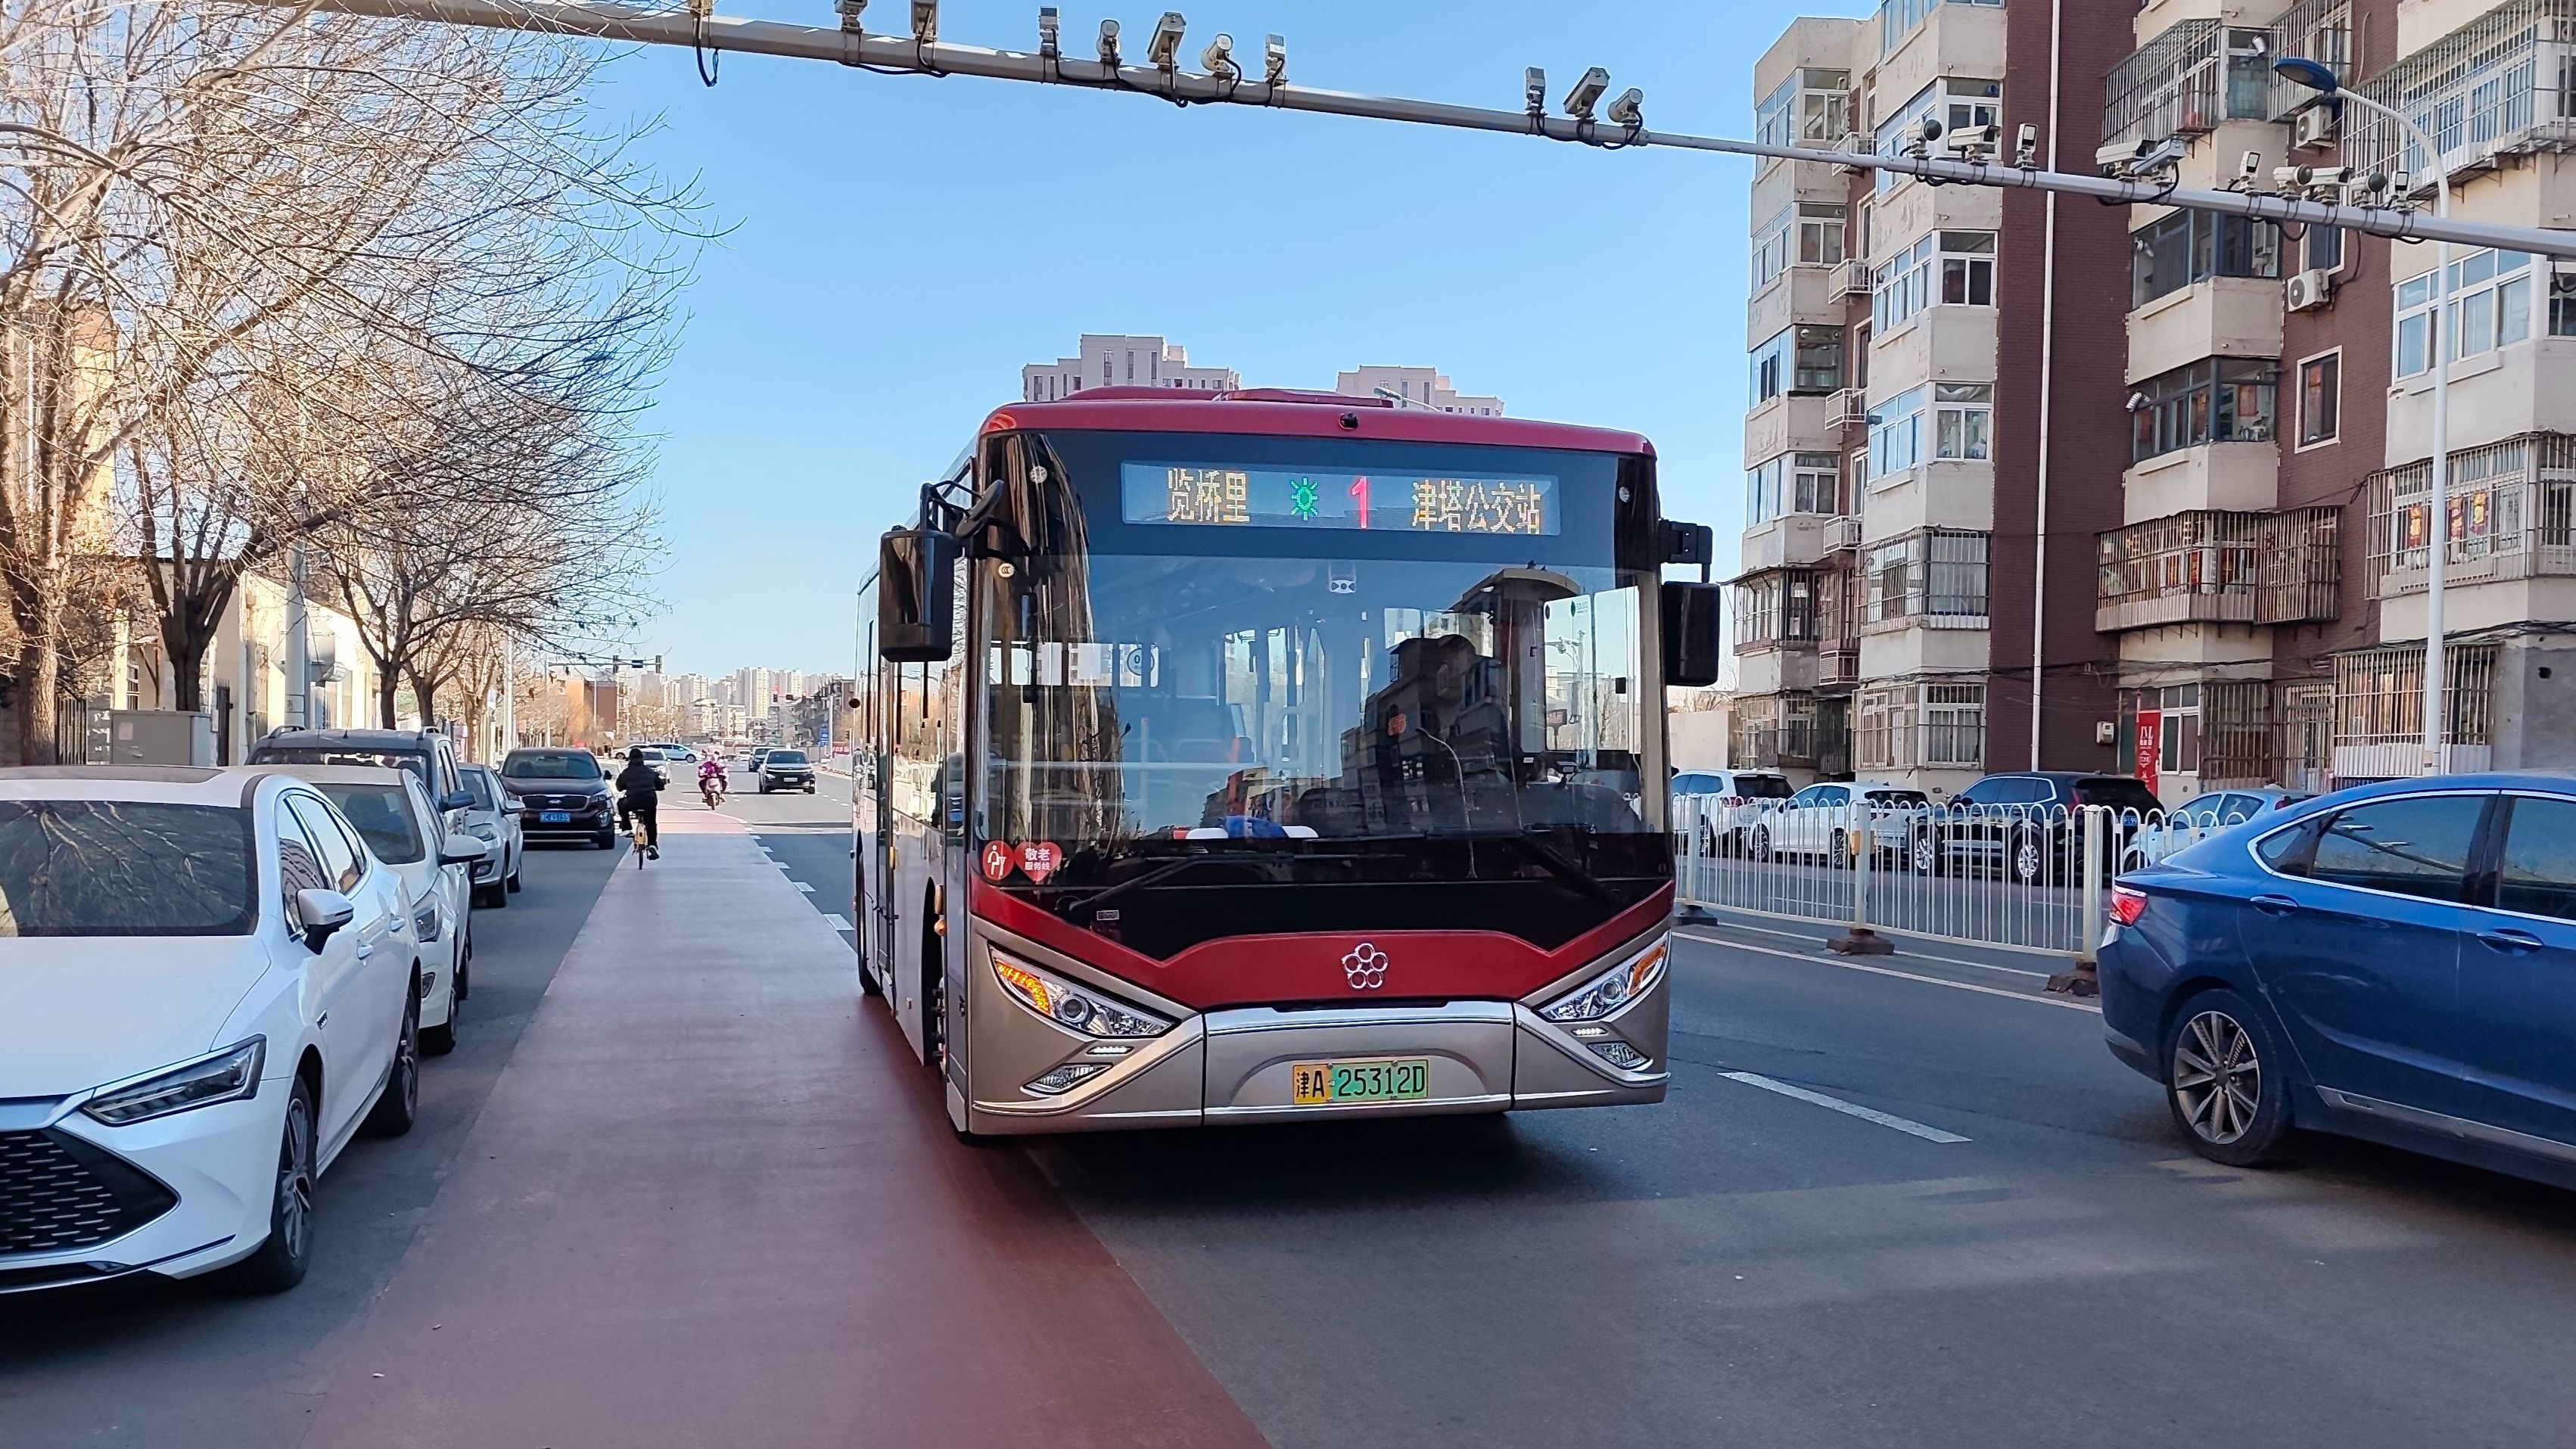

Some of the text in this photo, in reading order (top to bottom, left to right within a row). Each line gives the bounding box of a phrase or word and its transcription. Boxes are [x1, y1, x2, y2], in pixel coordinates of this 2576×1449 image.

[1167, 468, 1541, 535] 览桥里 1 津塔公交站
[1025, 847, 1051, 861] 敬老
